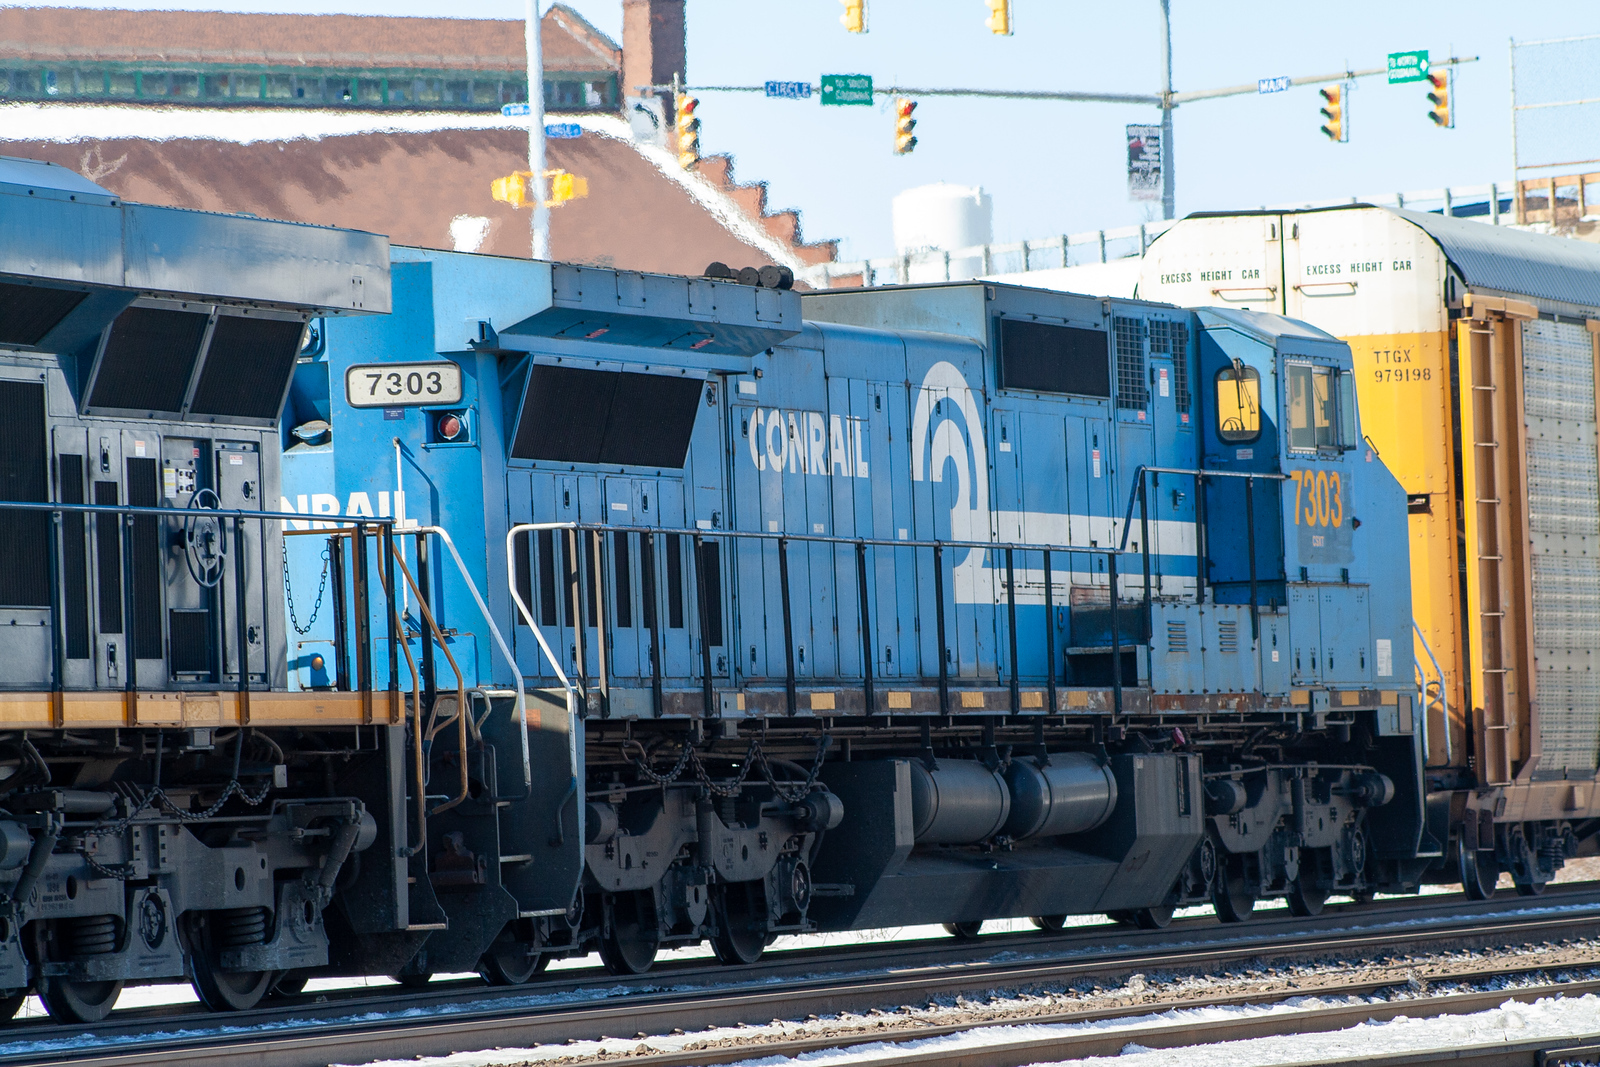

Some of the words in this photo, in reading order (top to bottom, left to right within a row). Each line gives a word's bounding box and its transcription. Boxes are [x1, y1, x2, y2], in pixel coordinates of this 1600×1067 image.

[767, 82, 810, 98] CIRCLE
[1260, 77, 1288, 93] MAIN
[1306, 264, 1341, 276] EXCESS
[1350, 261, 1383, 273] HEIGHT
[1392, 260, 1412, 271] CAR
[1161, 272, 1192, 284] EXCESS
[1200, 270, 1232, 281] HEIGHT
[1241, 269, 1260, 280] CAR
[1373, 349, 1411, 364] TTGX
[1374, 368, 1431, 382] 979198
[366, 371, 442, 396] 7303
[748, 407, 869, 478] CONRAIL
[1290, 469, 1343, 529] 7303
